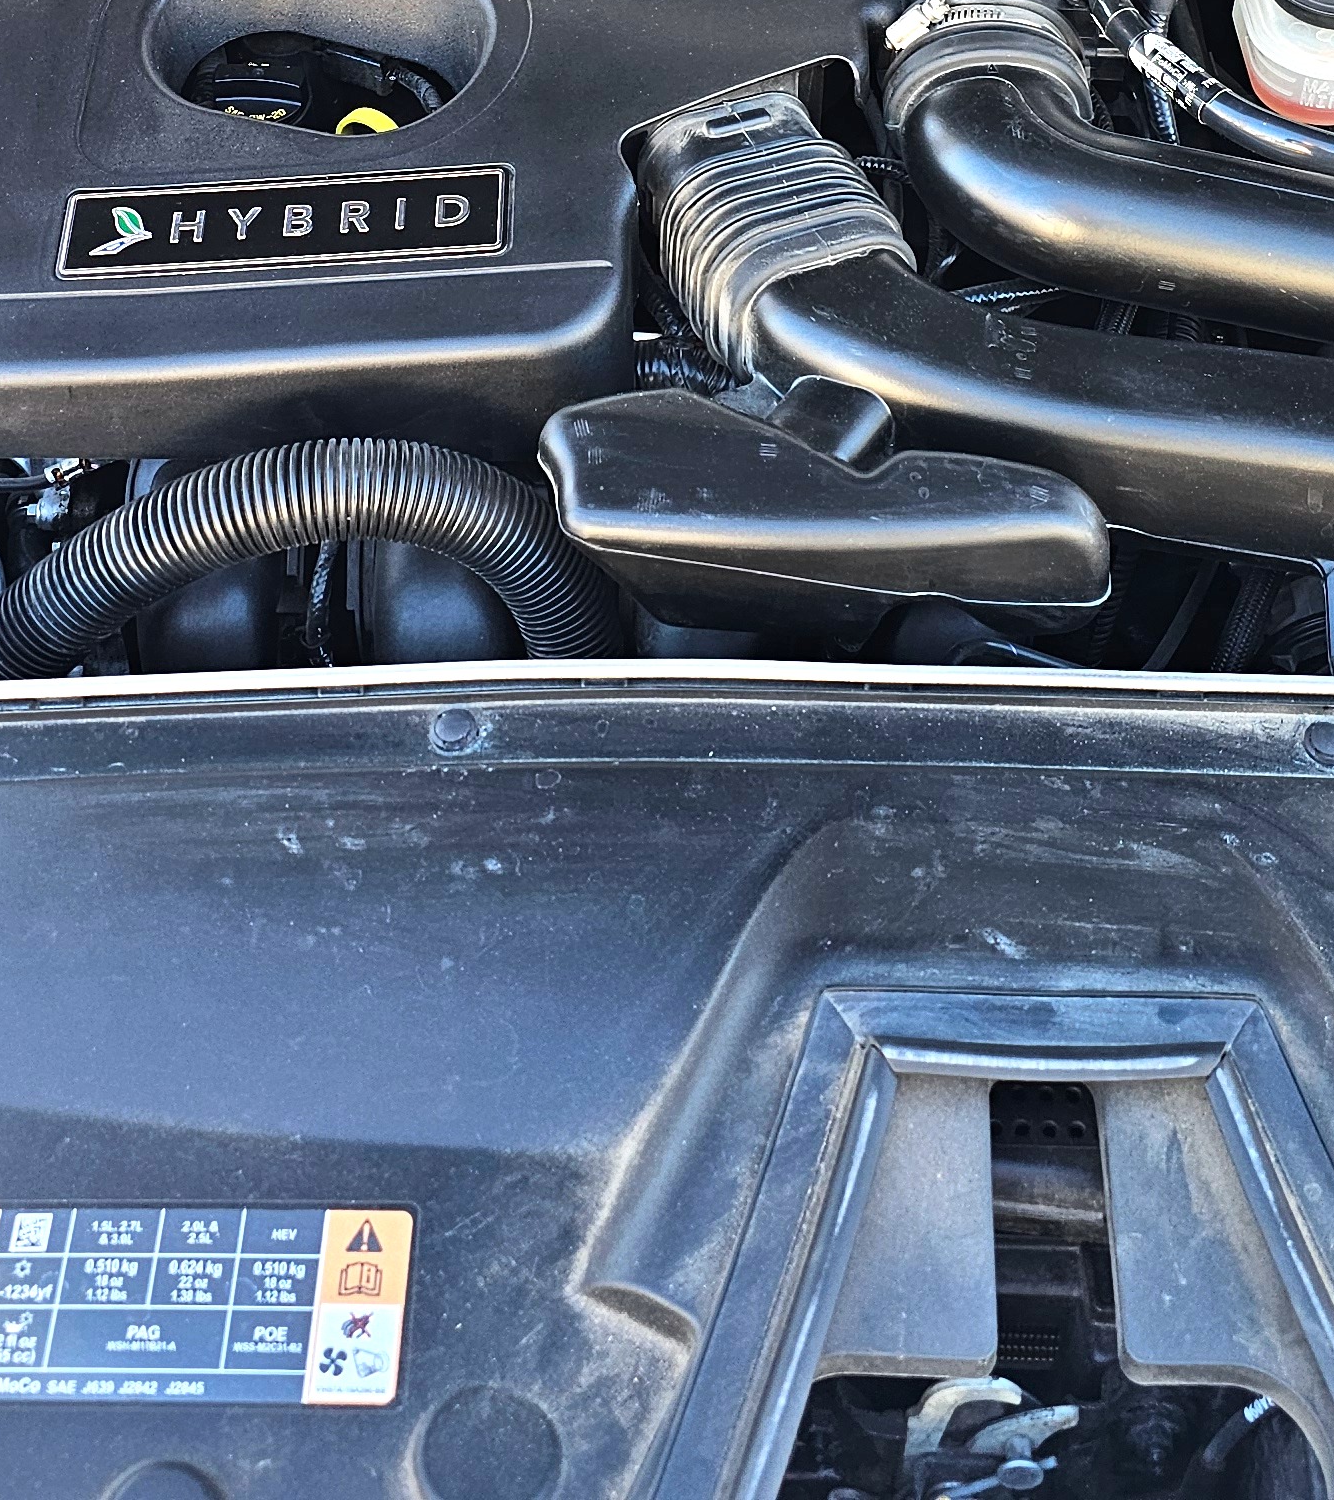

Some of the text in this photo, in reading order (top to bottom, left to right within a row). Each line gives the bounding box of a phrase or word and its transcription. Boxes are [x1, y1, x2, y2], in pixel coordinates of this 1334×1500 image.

[169, 195, 470, 243] HYBRID
[118, 1220, 144, 1233] 2.7L
[180, 1220, 219, 1233] 2.0L &
[98, 1233, 134, 1246] & 3.0L
[187, 1232, 214, 1245] 2.5L
[271, 1228, 298, 1241] HEV
[84, 1258, 139, 1278] 0.510 kg
[168, 1259, 223, 1279] 0.624 kg
[252, 1261, 306, 1280] 0.510 kg
[95, 1274, 124, 1288] 18 oz
[177, 1276, 209, 1290] 22 oz
[264, 1277, 293, 1290] 18 oz
[85, 1288, 128, 1302] 1.12 lbs
[195, 1290, 213, 1303] lbs
[255, 1290, 297, 1304] 1.12 lbs
[125, 1325, 161, 1341] PAG
[252, 1326, 289, 1342] POE
[5, 1333, 18, 1349] fl
[18, 1336, 38, 1349] oz
[12, 1348, 37, 1367] cc)
[46, 1380, 78, 1395] SAE
